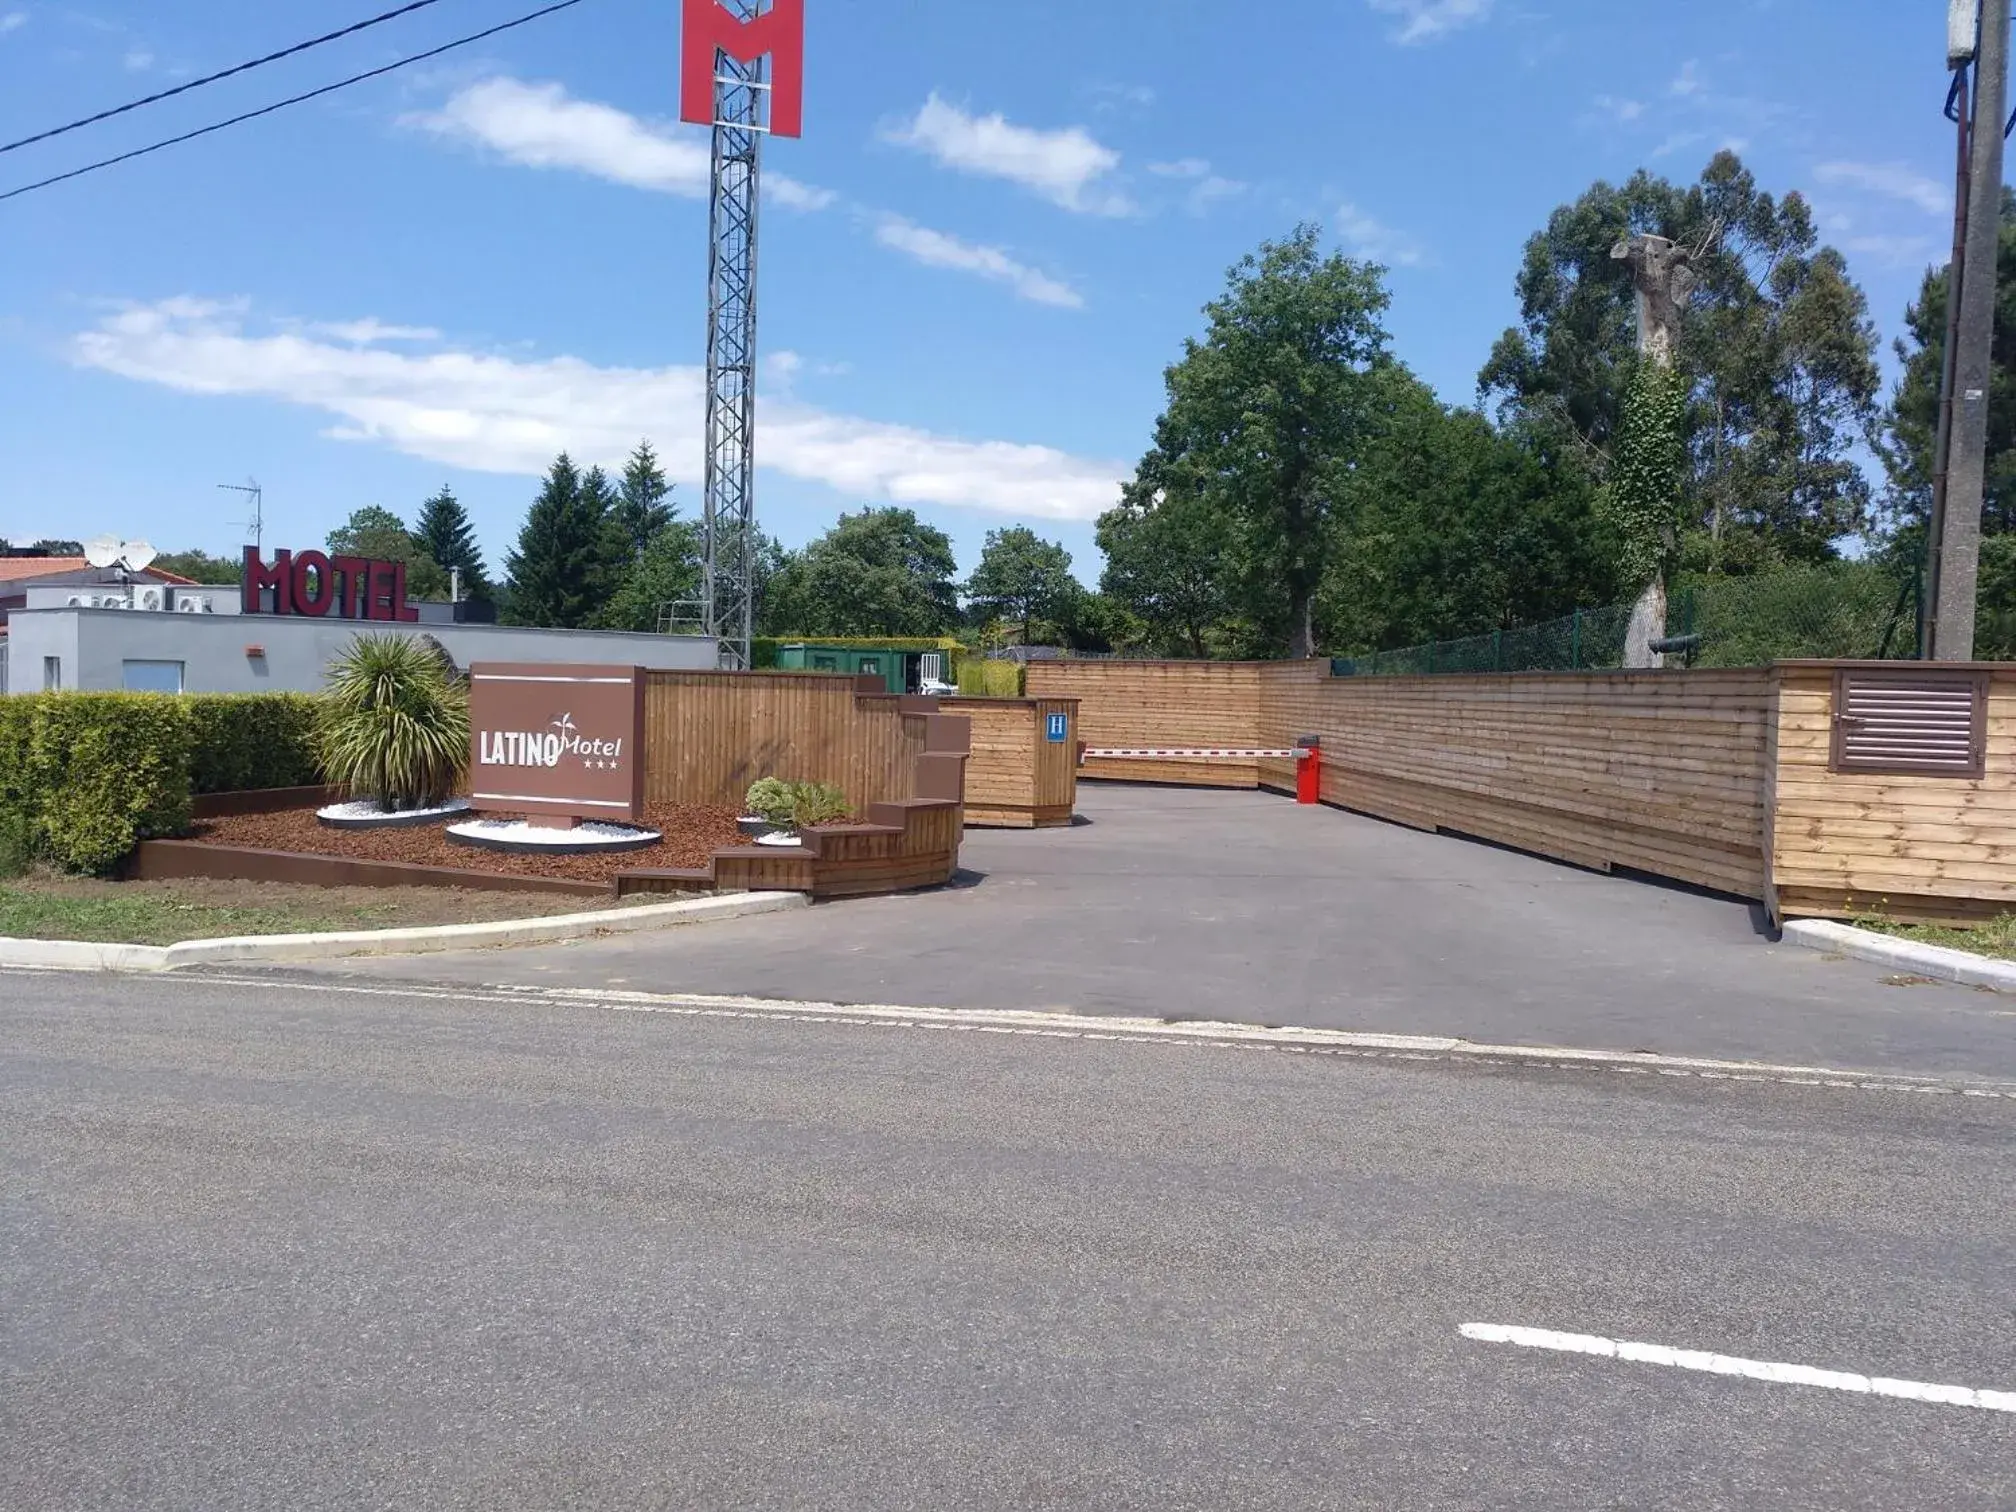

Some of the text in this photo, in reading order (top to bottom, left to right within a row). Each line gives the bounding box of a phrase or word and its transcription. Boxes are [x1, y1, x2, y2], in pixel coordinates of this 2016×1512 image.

[680, 0, 804, 138] M
[241, 545, 419, 622] MOTEL
[480, 730, 622, 767] LATINO Motel
[1051, 715, 1063, 734] H
